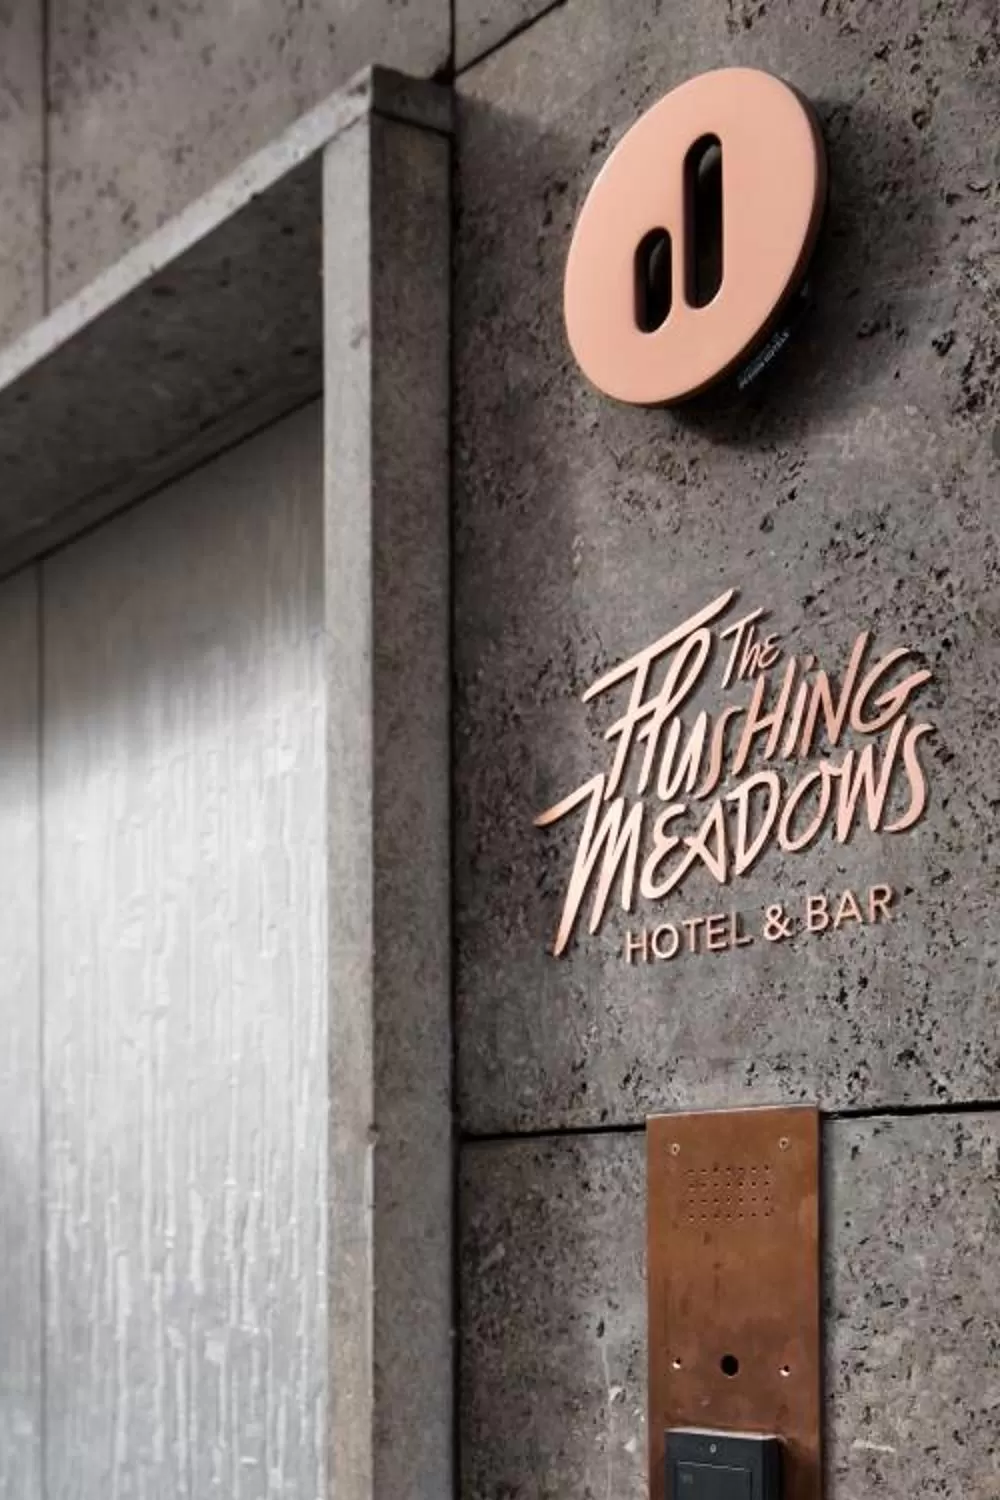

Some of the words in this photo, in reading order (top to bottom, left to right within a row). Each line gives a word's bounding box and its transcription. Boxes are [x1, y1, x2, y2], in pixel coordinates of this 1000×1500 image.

[532, 714, 935, 957] MEADOWS
[624, 910, 753, 963] HOTEL
[762, 902, 792, 942] &
[805, 883, 894, 932] BAR
